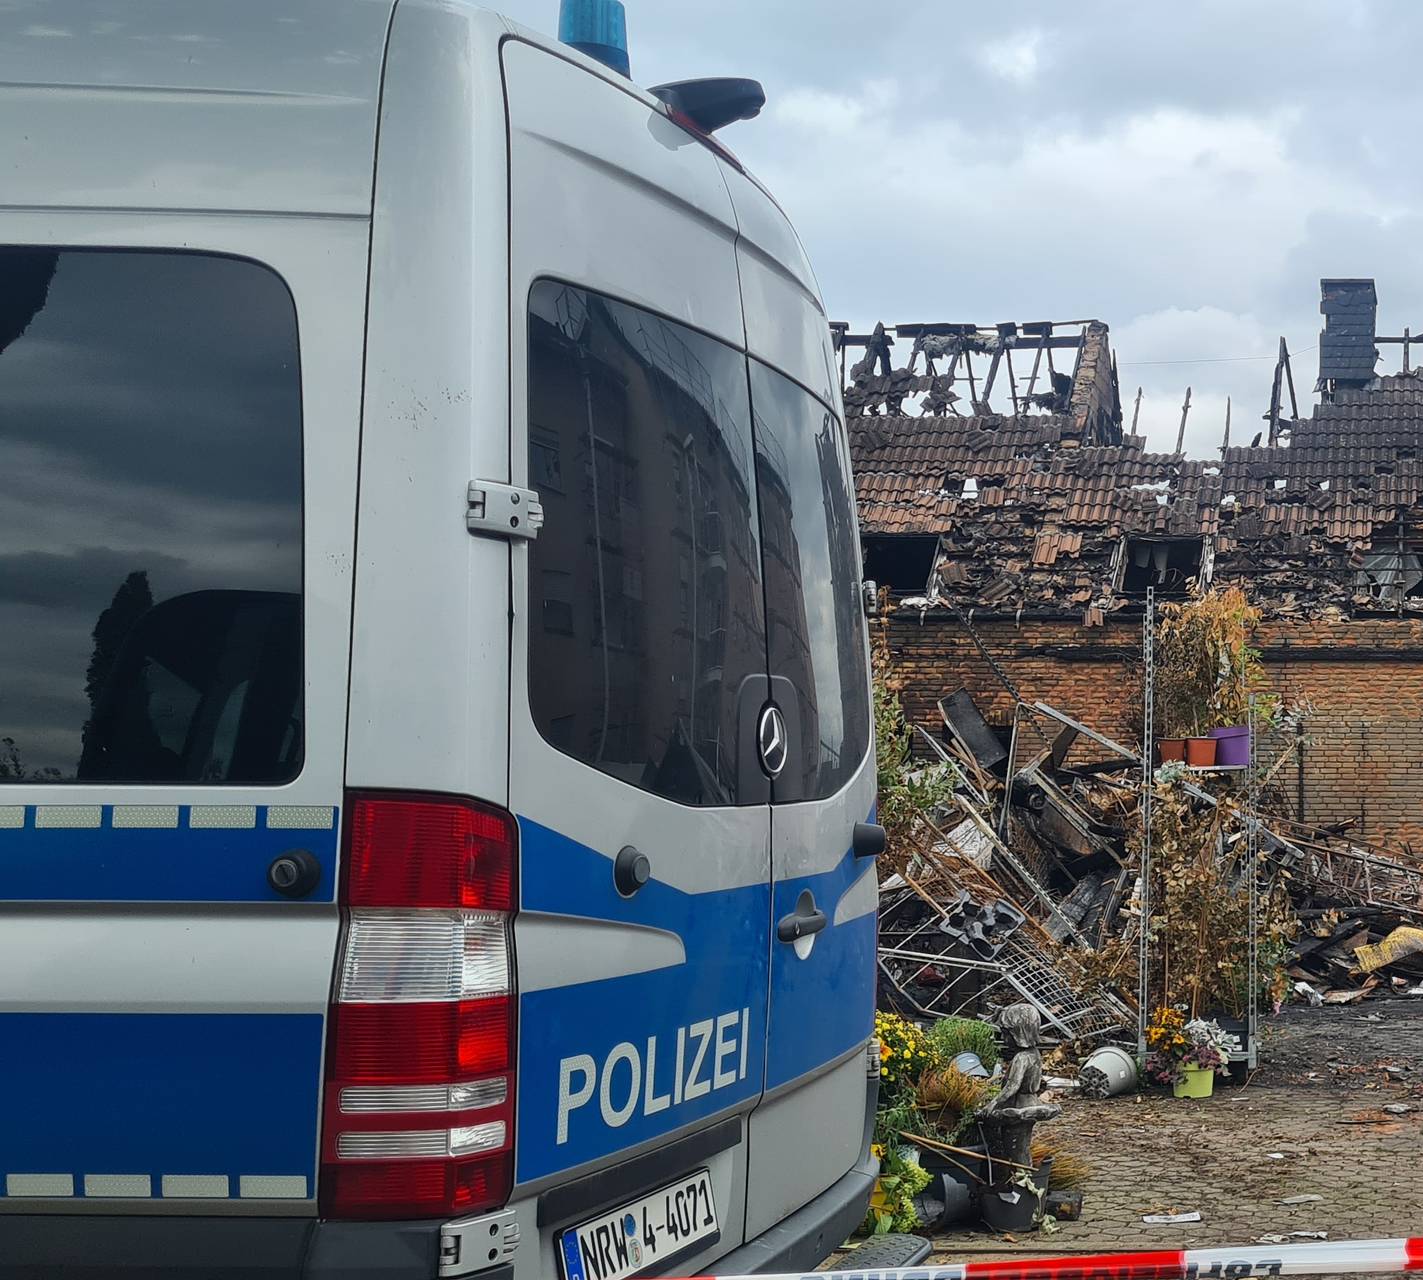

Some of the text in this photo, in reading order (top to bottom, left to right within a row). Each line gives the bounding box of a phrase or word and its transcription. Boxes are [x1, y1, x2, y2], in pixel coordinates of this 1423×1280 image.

[556, 1007, 750, 1145] POLIZEI
[580, 1179, 714, 1280] NRW 4-4071
